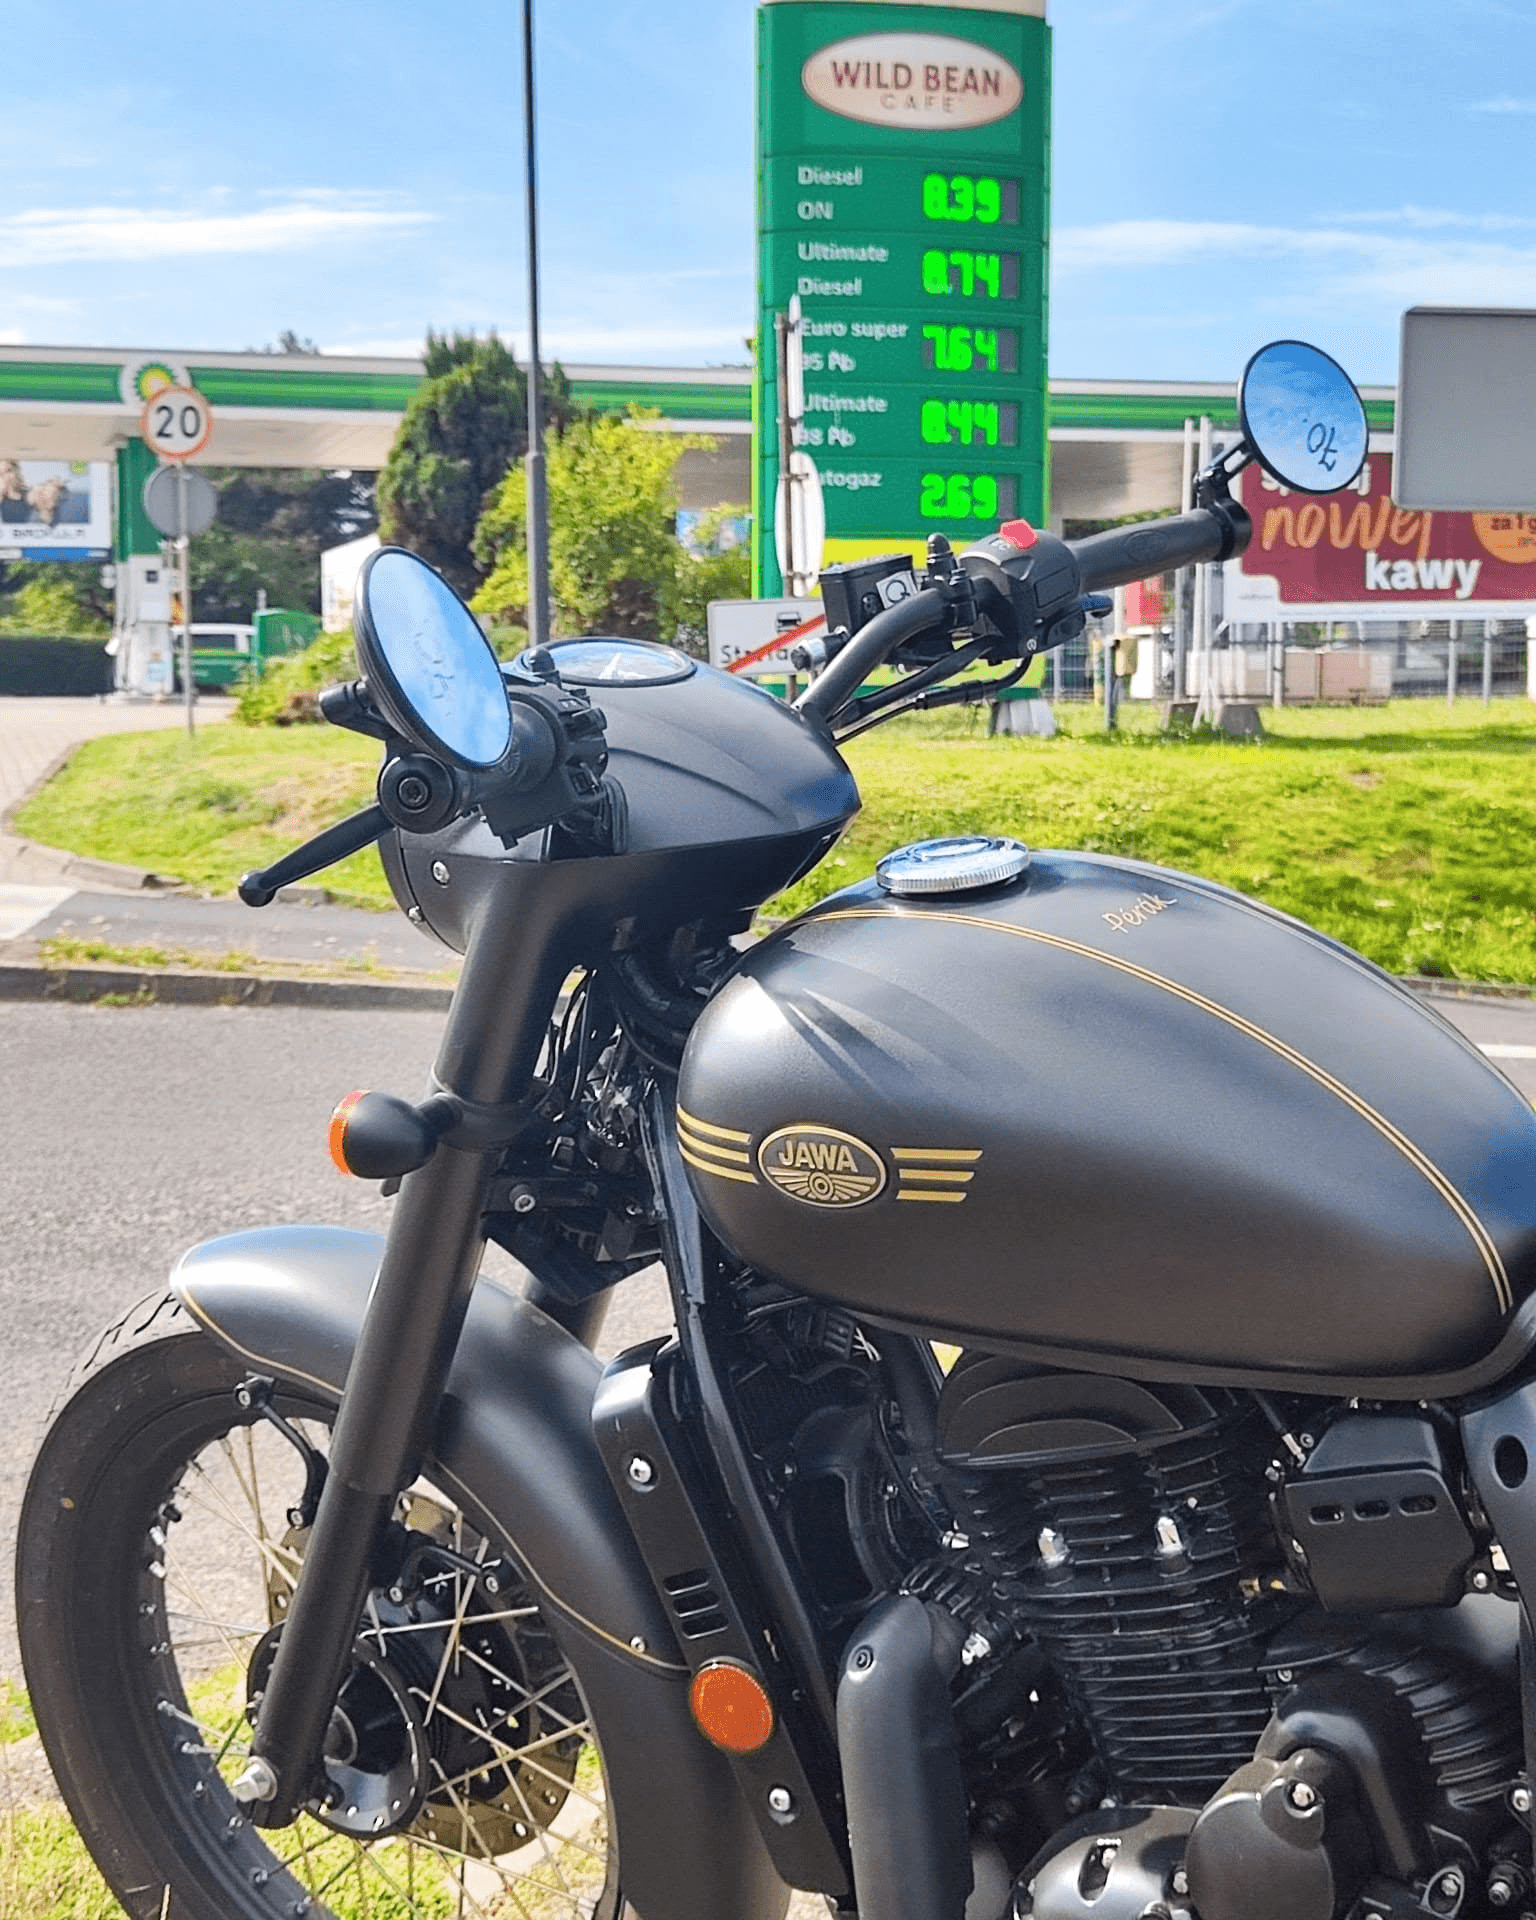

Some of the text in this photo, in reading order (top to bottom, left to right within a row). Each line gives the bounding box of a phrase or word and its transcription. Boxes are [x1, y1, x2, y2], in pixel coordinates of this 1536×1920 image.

[832, 61, 1001, 97] WILD BEAN
[797, 165, 863, 186] Diesel
[797, 200, 834, 221] ON
[797, 240, 889, 263] Ultimate
[797, 276, 863, 297] Diesel
[799, 317, 909, 342] Euro super
[827, 349, 857, 374] Pb
[156, 405, 202, 438] 20
[827, 424, 857, 448] Pb
[819, 469, 883, 491] togaz
[1364, 549, 1483, 601] kawy
[778, 1139, 860, 1174] JAWA
